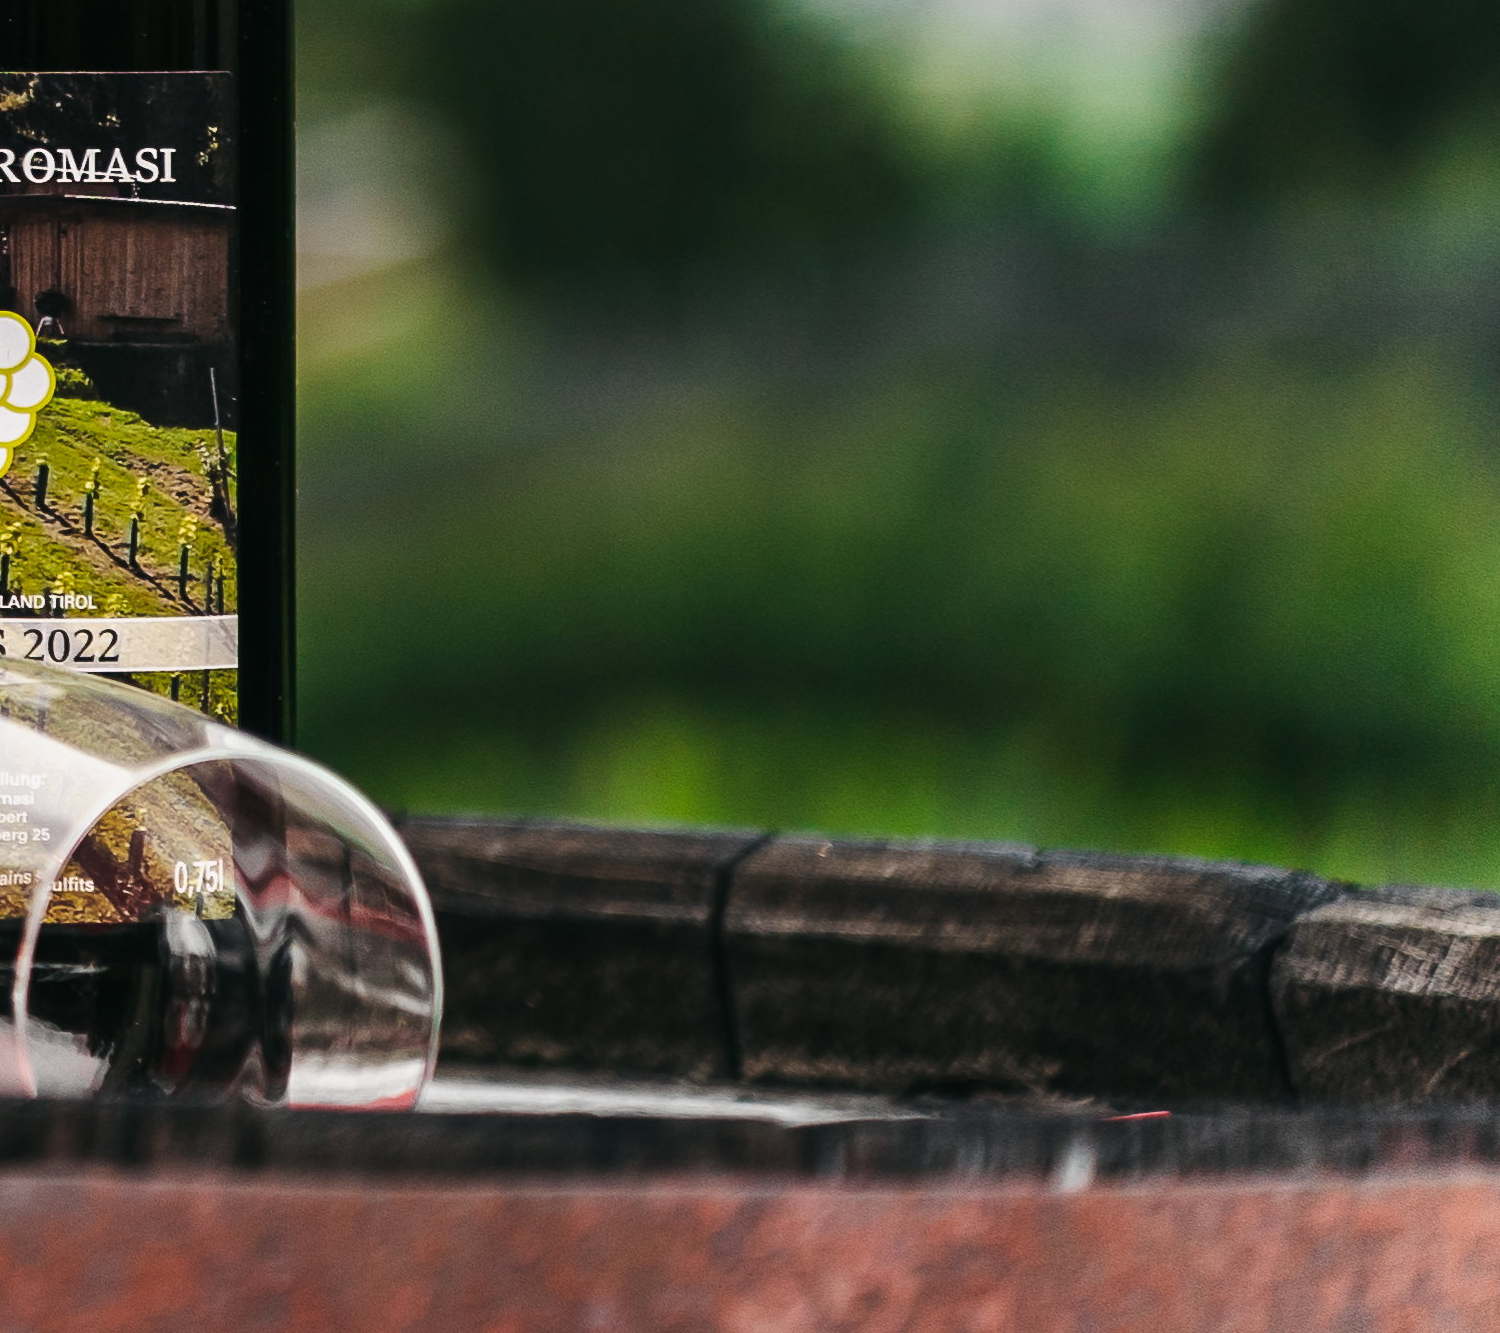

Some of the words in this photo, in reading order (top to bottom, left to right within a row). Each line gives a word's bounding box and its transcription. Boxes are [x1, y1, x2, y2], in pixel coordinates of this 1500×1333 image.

[49, 593, 98, 610] TIROL
[23, 628, 120, 663] 2022
[32, 827, 51, 842] 25
